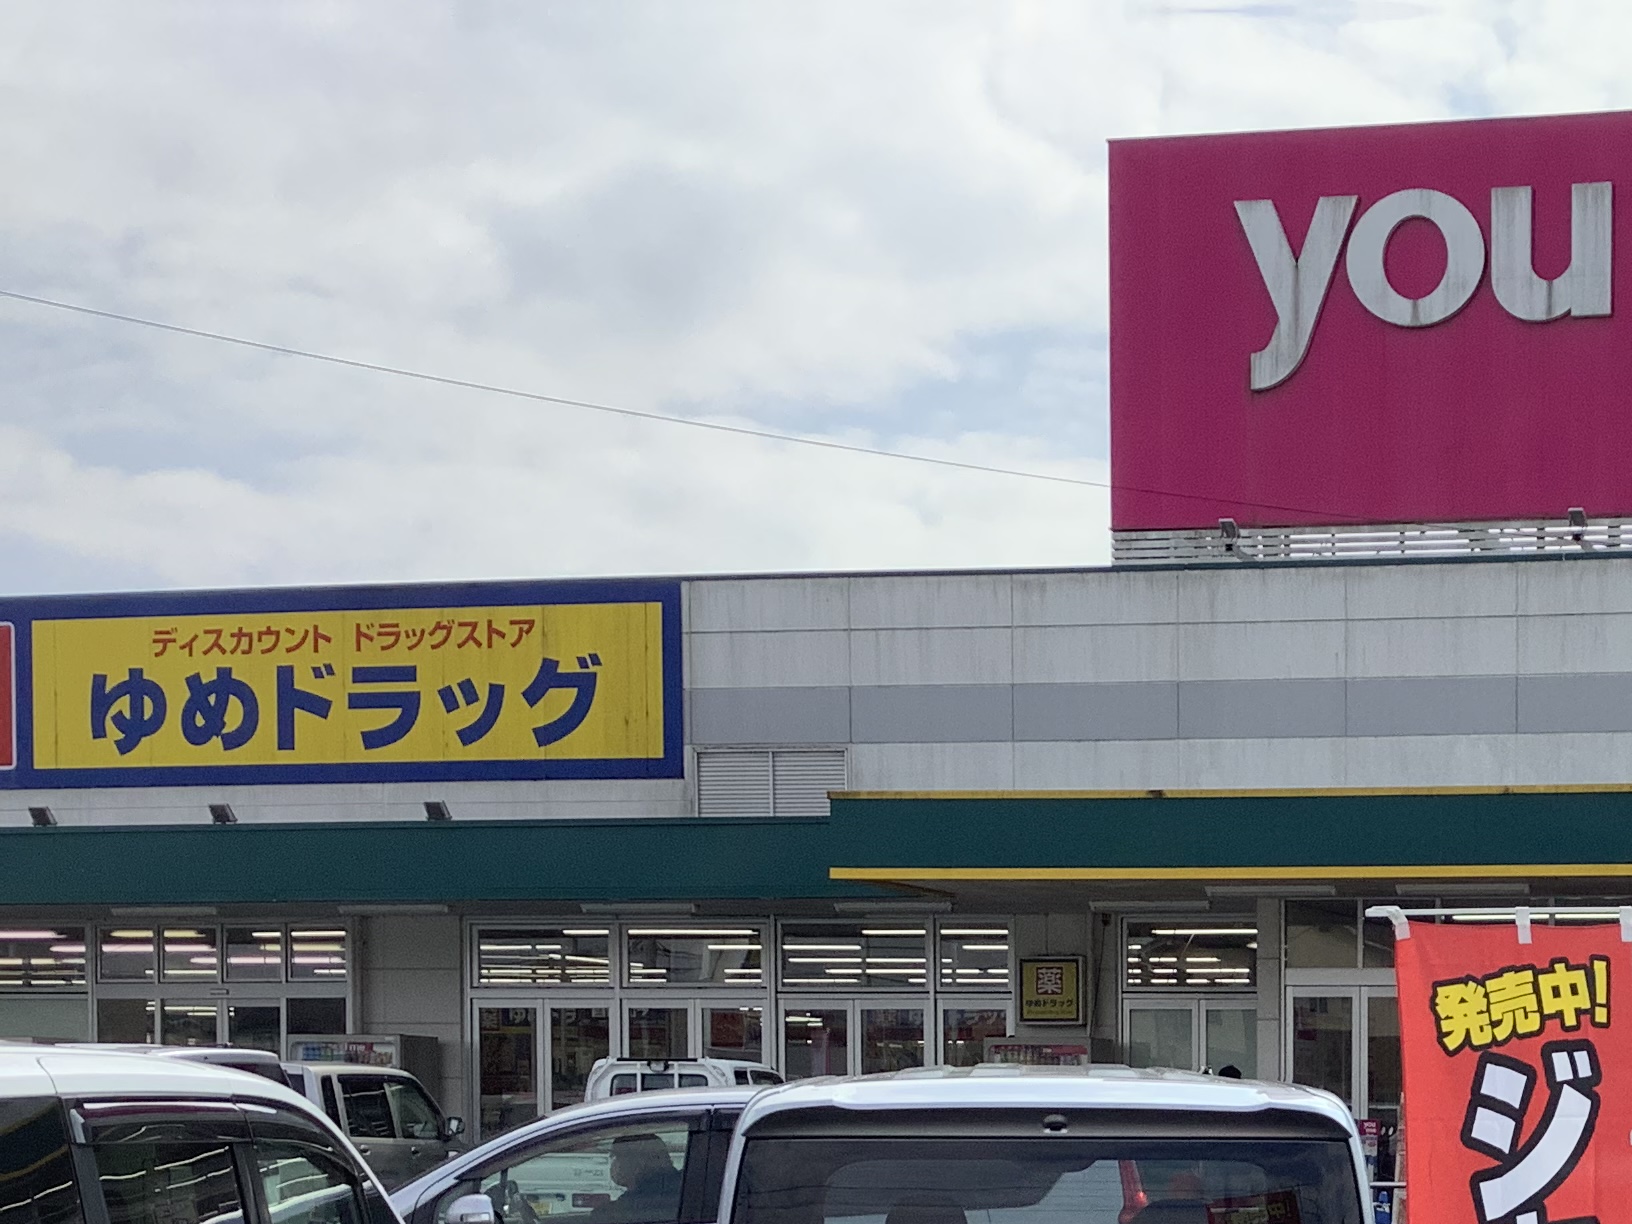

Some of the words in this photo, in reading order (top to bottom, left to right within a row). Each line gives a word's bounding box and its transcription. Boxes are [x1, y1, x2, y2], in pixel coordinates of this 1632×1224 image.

[1233, 181, 1613, 391] you
[152, 624, 333, 658] ディスカウント
[354, 617, 536, 653] ドラッグストア
[90, 652, 603, 756] ゆめドラッグ
[1037, 967, 1063, 995] 薬
[1434, 959, 1610, 1052] 発売中!
